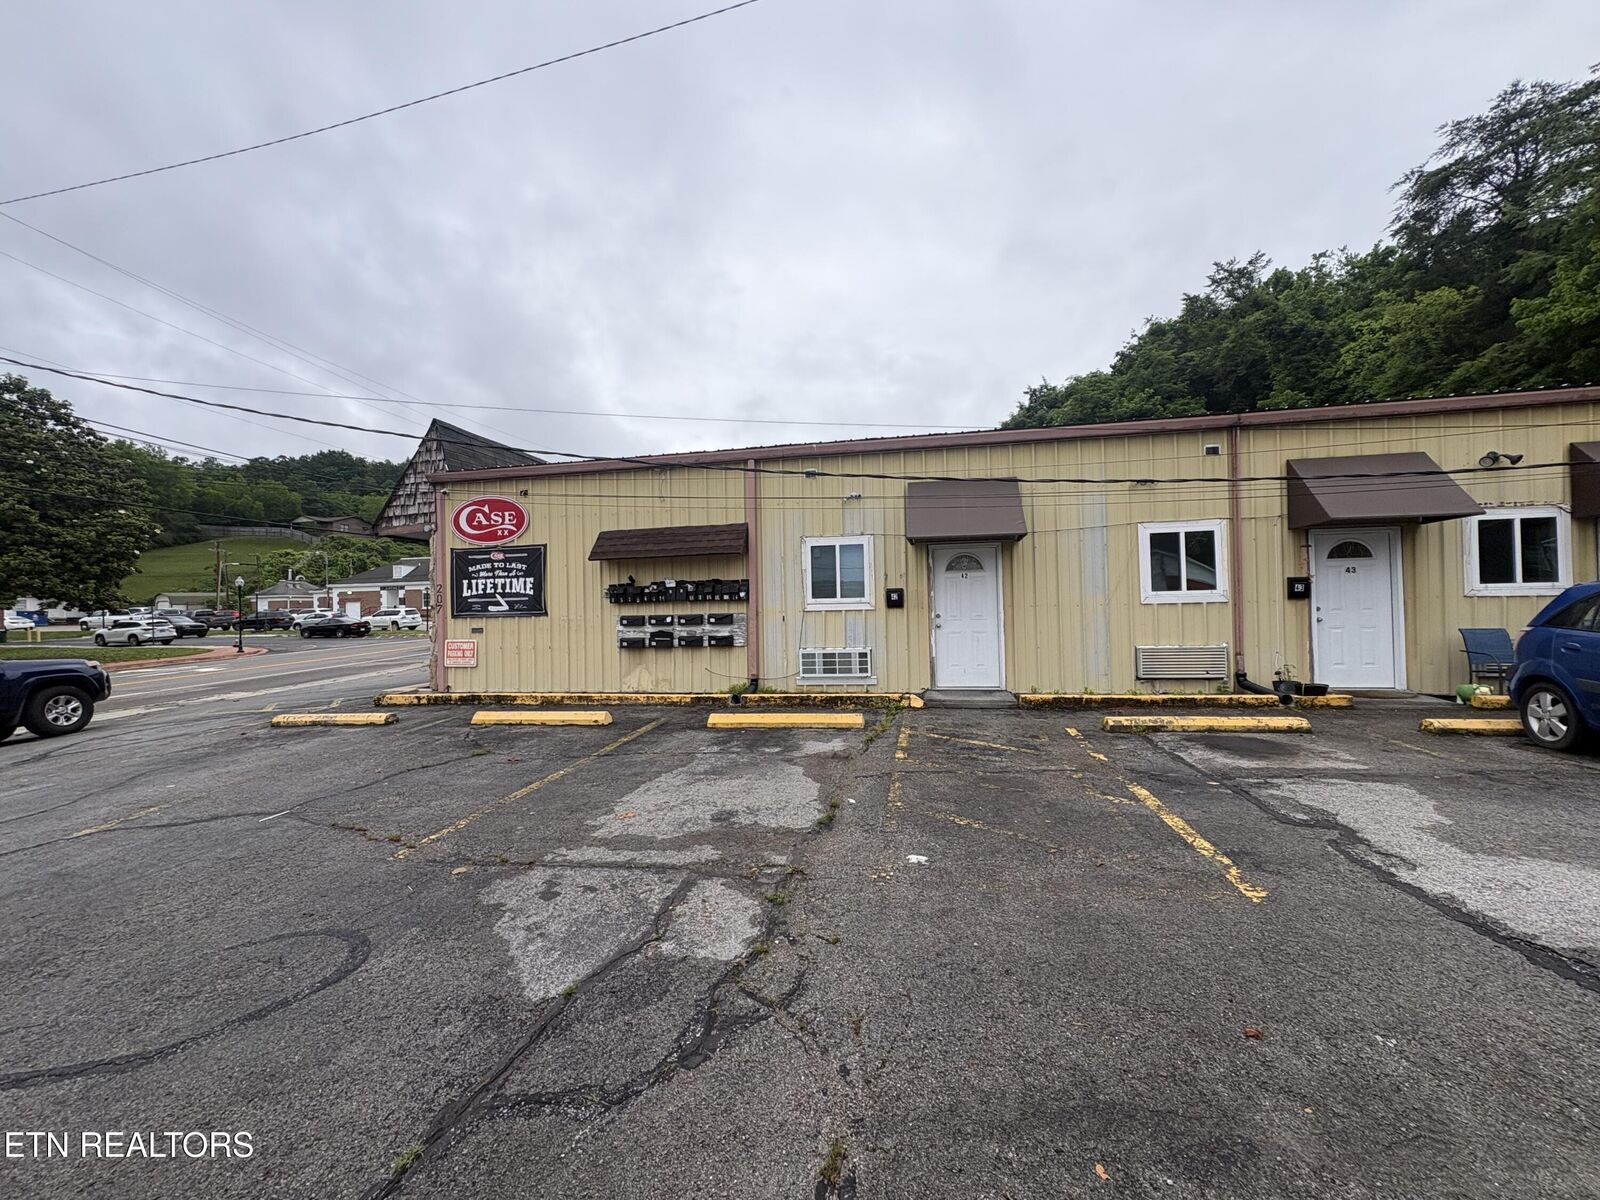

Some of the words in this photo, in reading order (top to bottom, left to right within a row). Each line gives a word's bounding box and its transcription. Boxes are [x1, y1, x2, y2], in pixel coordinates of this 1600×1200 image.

[459, 504, 518, 534] CASE
[468, 563, 492, 572] MADE
[462, 577, 534, 597] LIFETIME
